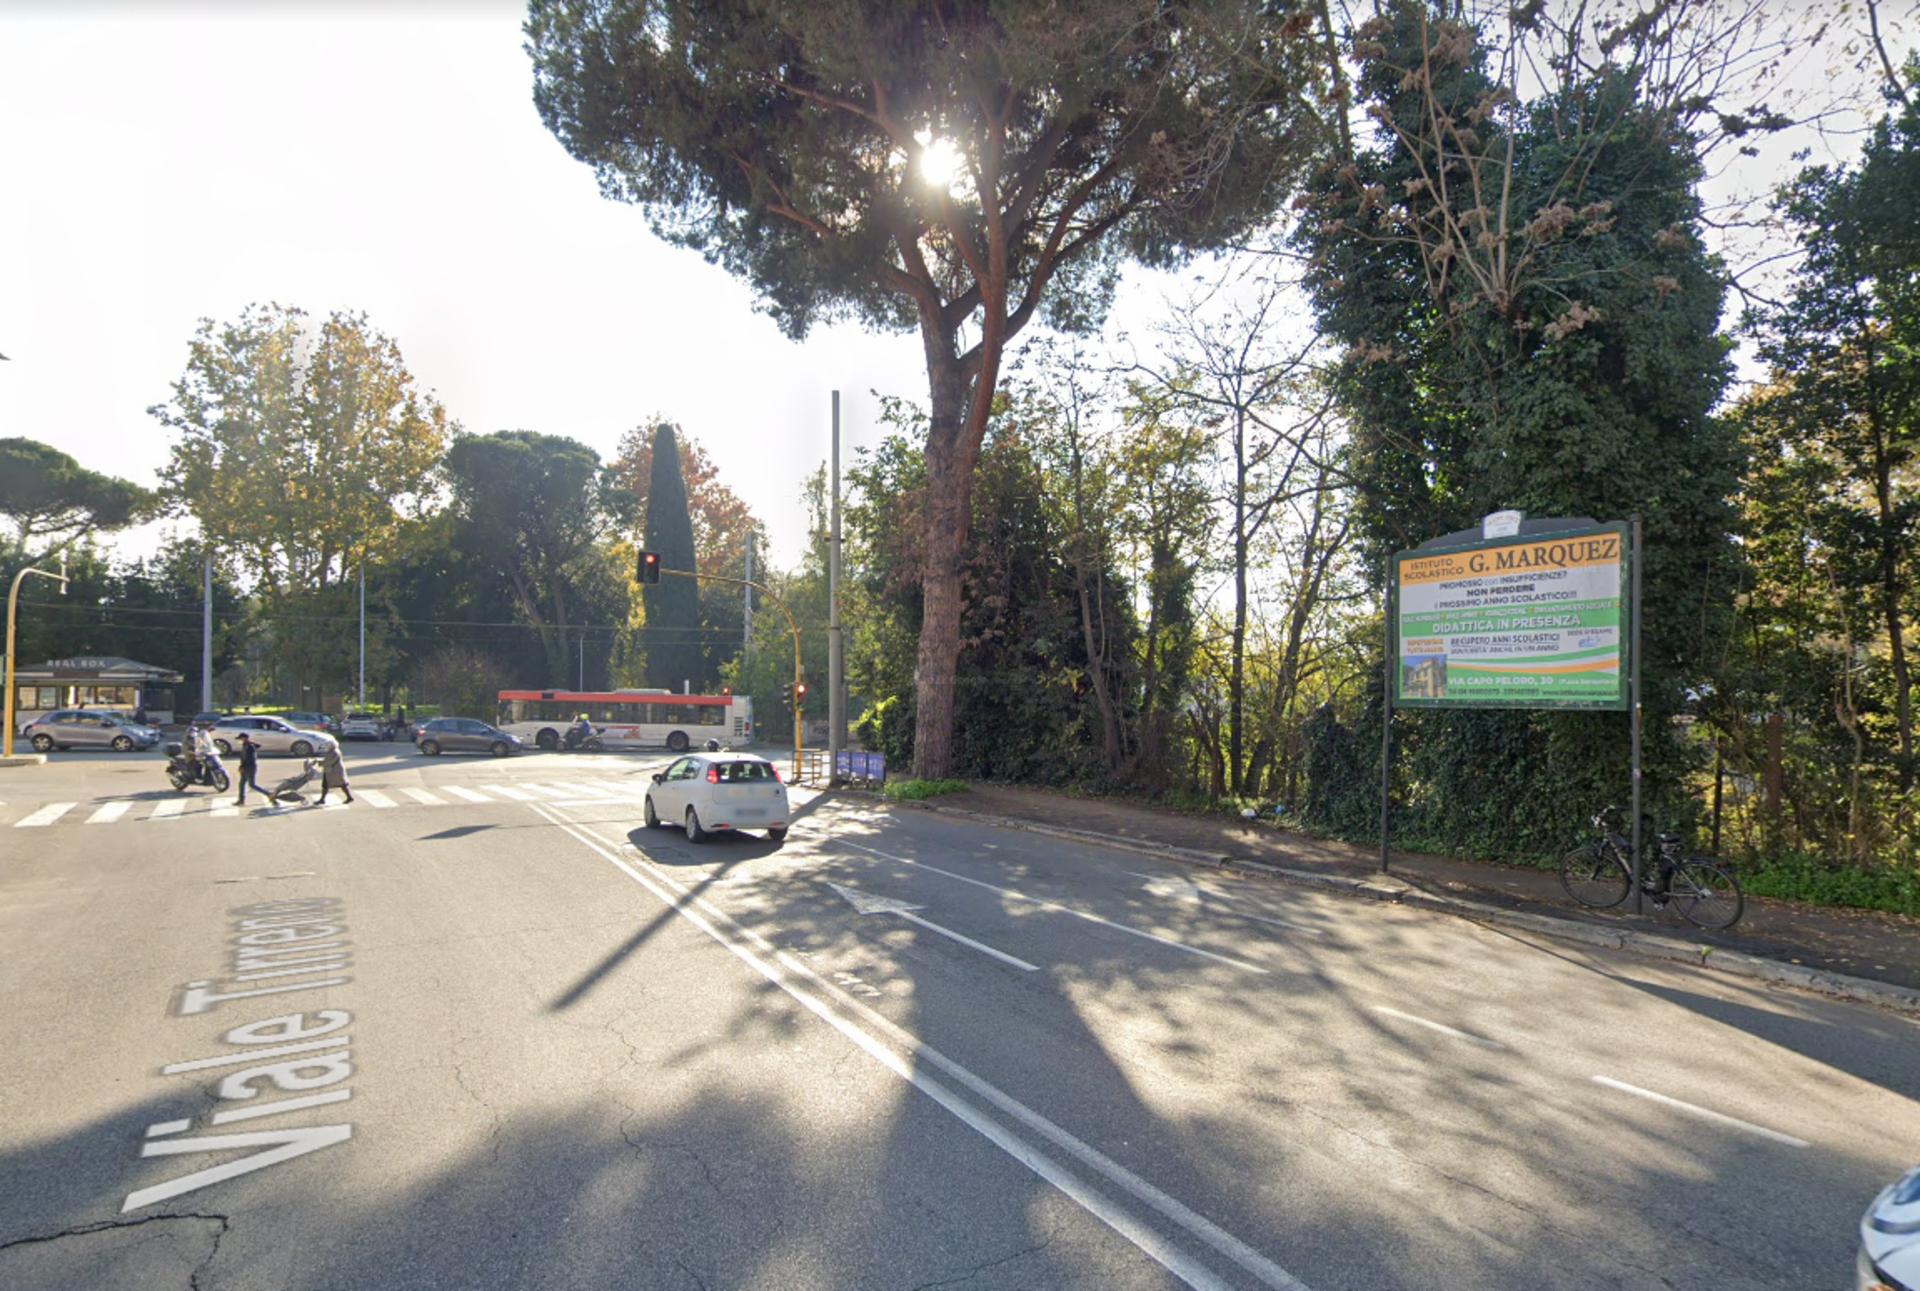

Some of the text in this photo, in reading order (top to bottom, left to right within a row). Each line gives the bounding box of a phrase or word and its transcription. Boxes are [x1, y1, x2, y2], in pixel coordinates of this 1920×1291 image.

[1469, 539, 1618, 573] G. MARQUEZ
[1411, 559, 1453, 571] ISTITUTO
[1404, 566, 1464, 580] SCOLASTICO
[1439, 578, 1483, 590] PROMOSSO
[1466, 583, 1536, 598] NON PERDERE
[1439, 598, 1482, 610] PROSSIMO
[1483, 596, 1509, 606] ANNO
[1432, 614, 1581, 634] DIDATTICA IN PRESENZA
[1450, 636, 1490, 646] RECUPERO
[1492, 634, 1511, 644] ANNI
[1513, 632, 1560, 644] SCOLASTICI
[1447, 676, 1465, 685] VIA
[1467, 676, 1493, 685] CAPO
